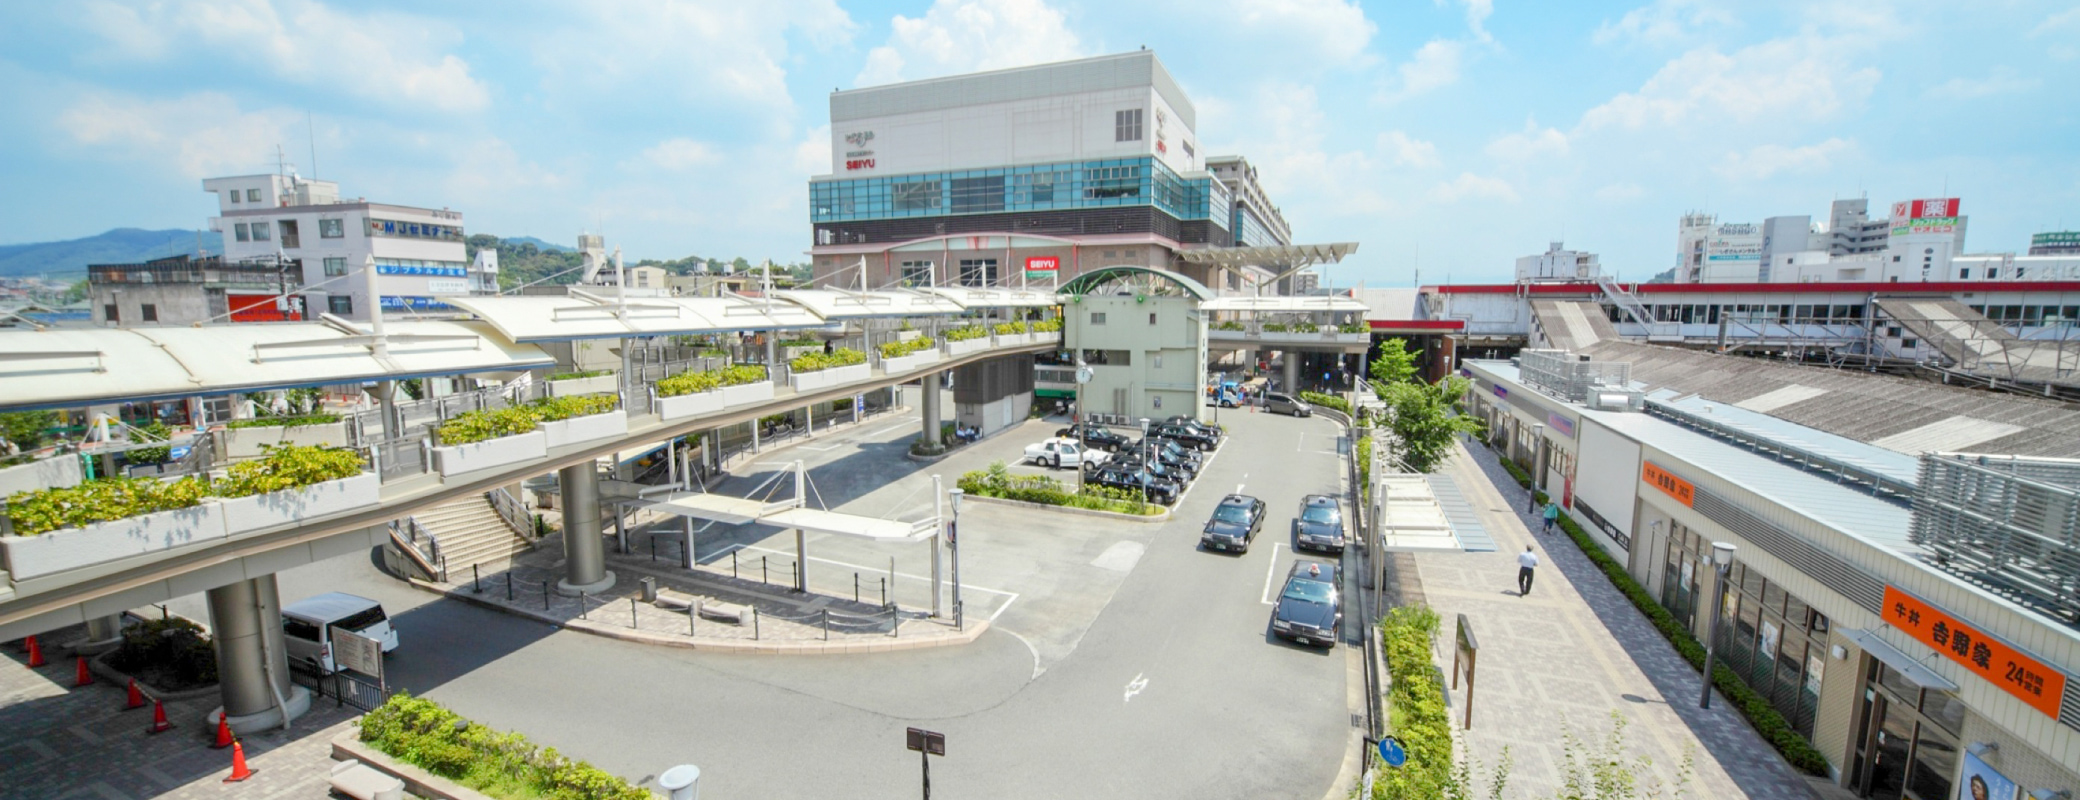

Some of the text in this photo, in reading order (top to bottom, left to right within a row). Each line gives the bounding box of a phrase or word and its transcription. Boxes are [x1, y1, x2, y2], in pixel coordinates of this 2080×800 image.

[846, 158, 875, 170] SEIYU
[1924, 200, 1947, 217] 薬
[1914, 225, 1952, 233] ヤオヒコ
[1030, 260, 1055, 269] SEIYU
[391, 265, 466, 276] ジブラルタ生命
[1895, 602, 1920, 627] 牛丼
[1932, 620, 1992, 670] 吉野家
